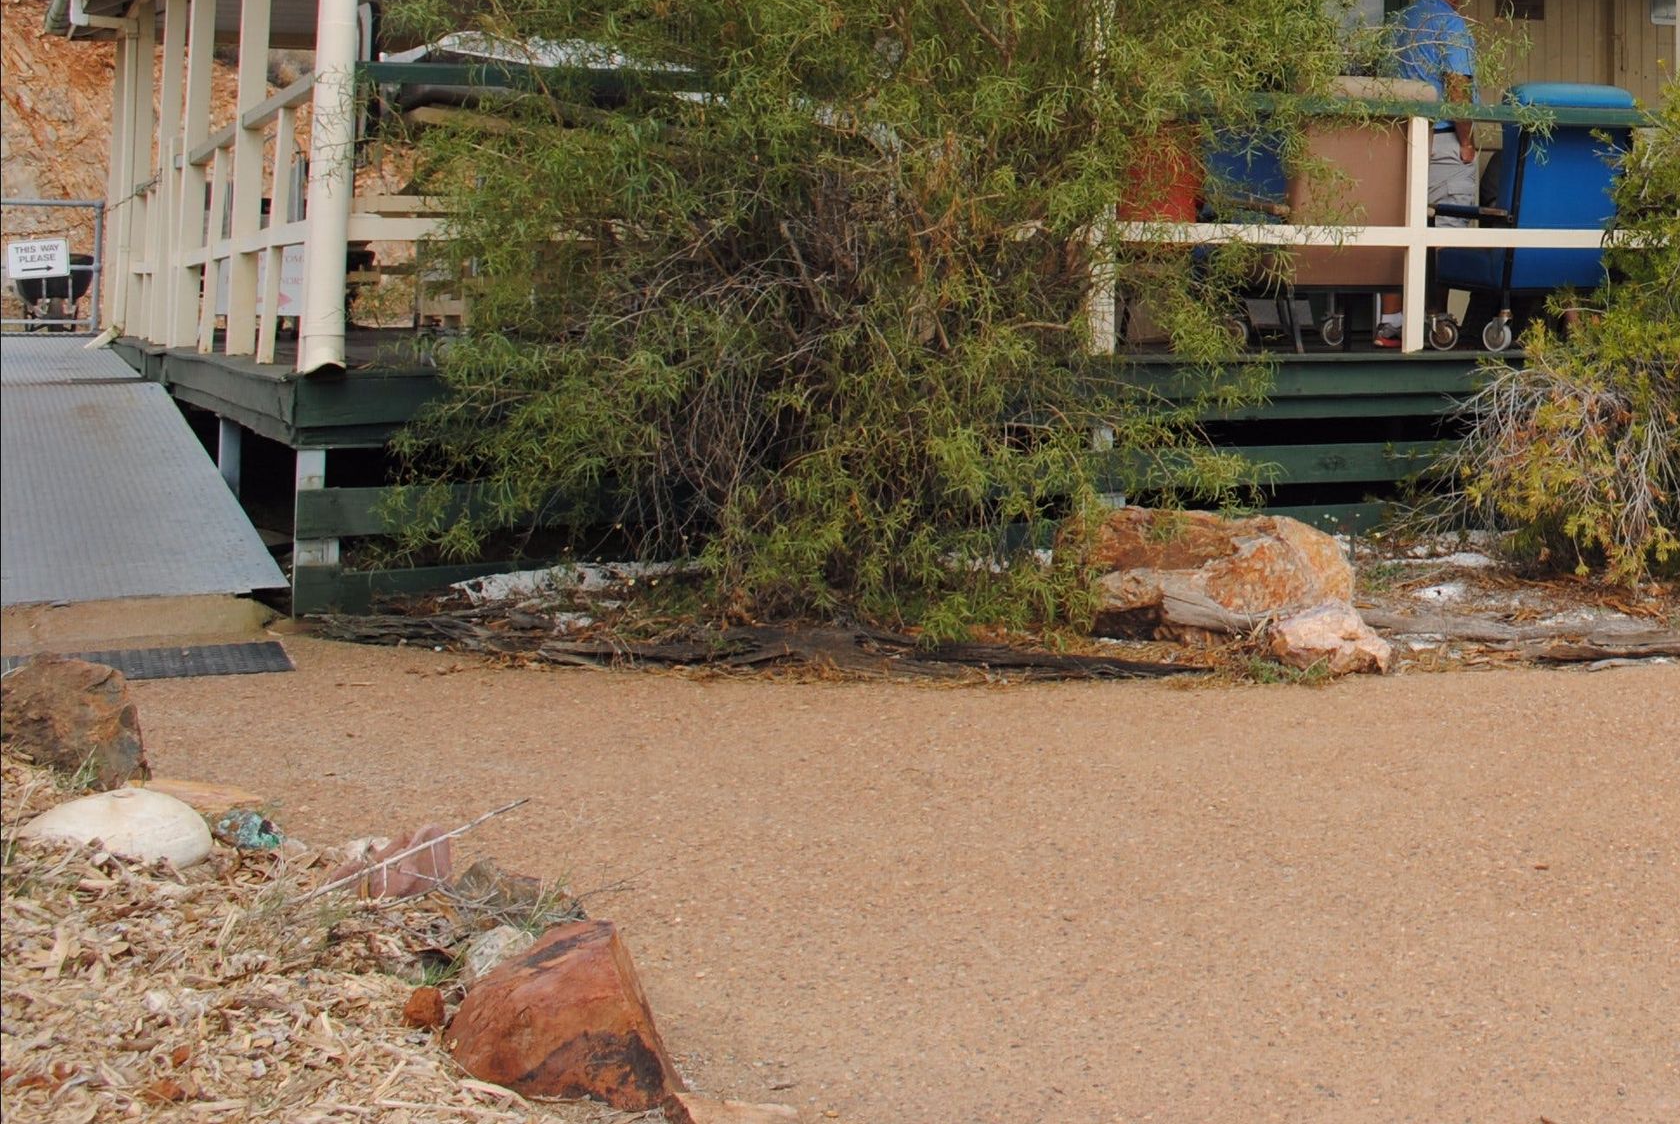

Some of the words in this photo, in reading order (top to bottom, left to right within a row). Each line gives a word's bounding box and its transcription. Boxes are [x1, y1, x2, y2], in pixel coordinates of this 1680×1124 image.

[15, 246, 36, 254] THIS
[41, 244, 59, 252] WAY
[19, 254, 56, 263] PLEASE
